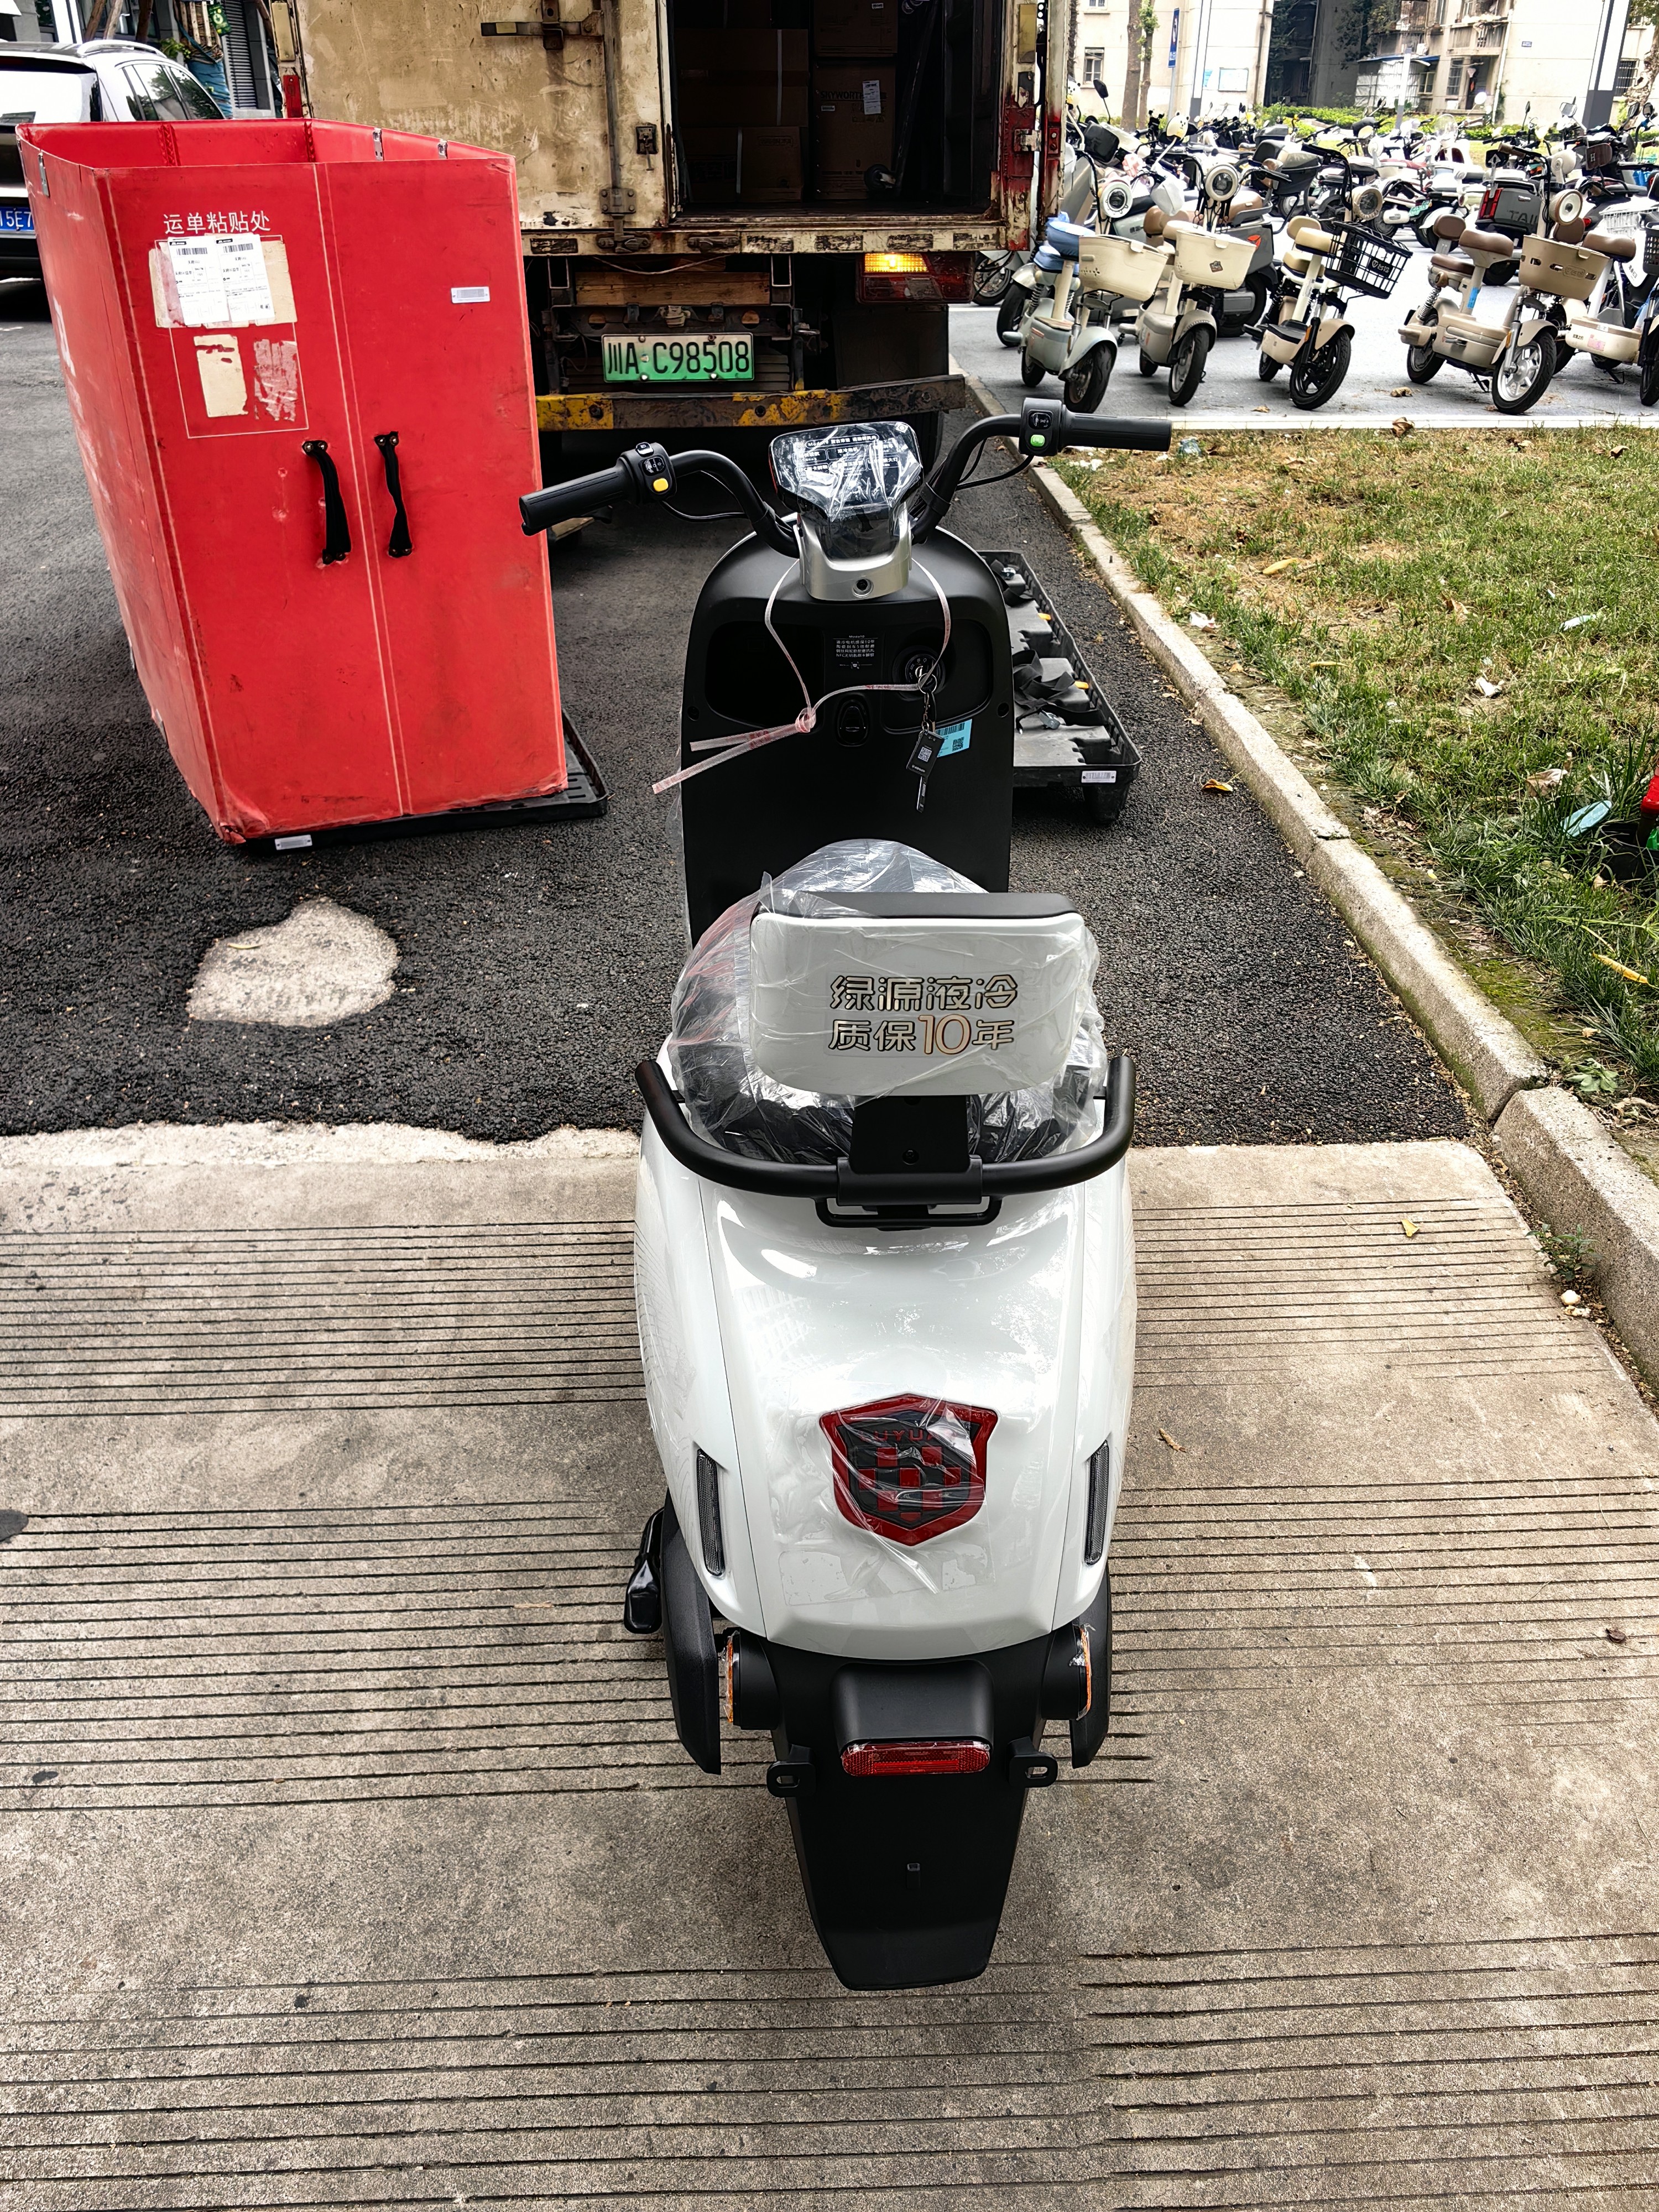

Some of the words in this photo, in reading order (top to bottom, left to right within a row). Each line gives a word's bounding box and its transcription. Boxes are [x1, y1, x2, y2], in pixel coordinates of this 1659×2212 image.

[164, 210, 271, 234] 运单粘贴处
[830, 974, 1019, 1011] 绿源液冷
[828, 1014, 1015, 1055] 质保10年
